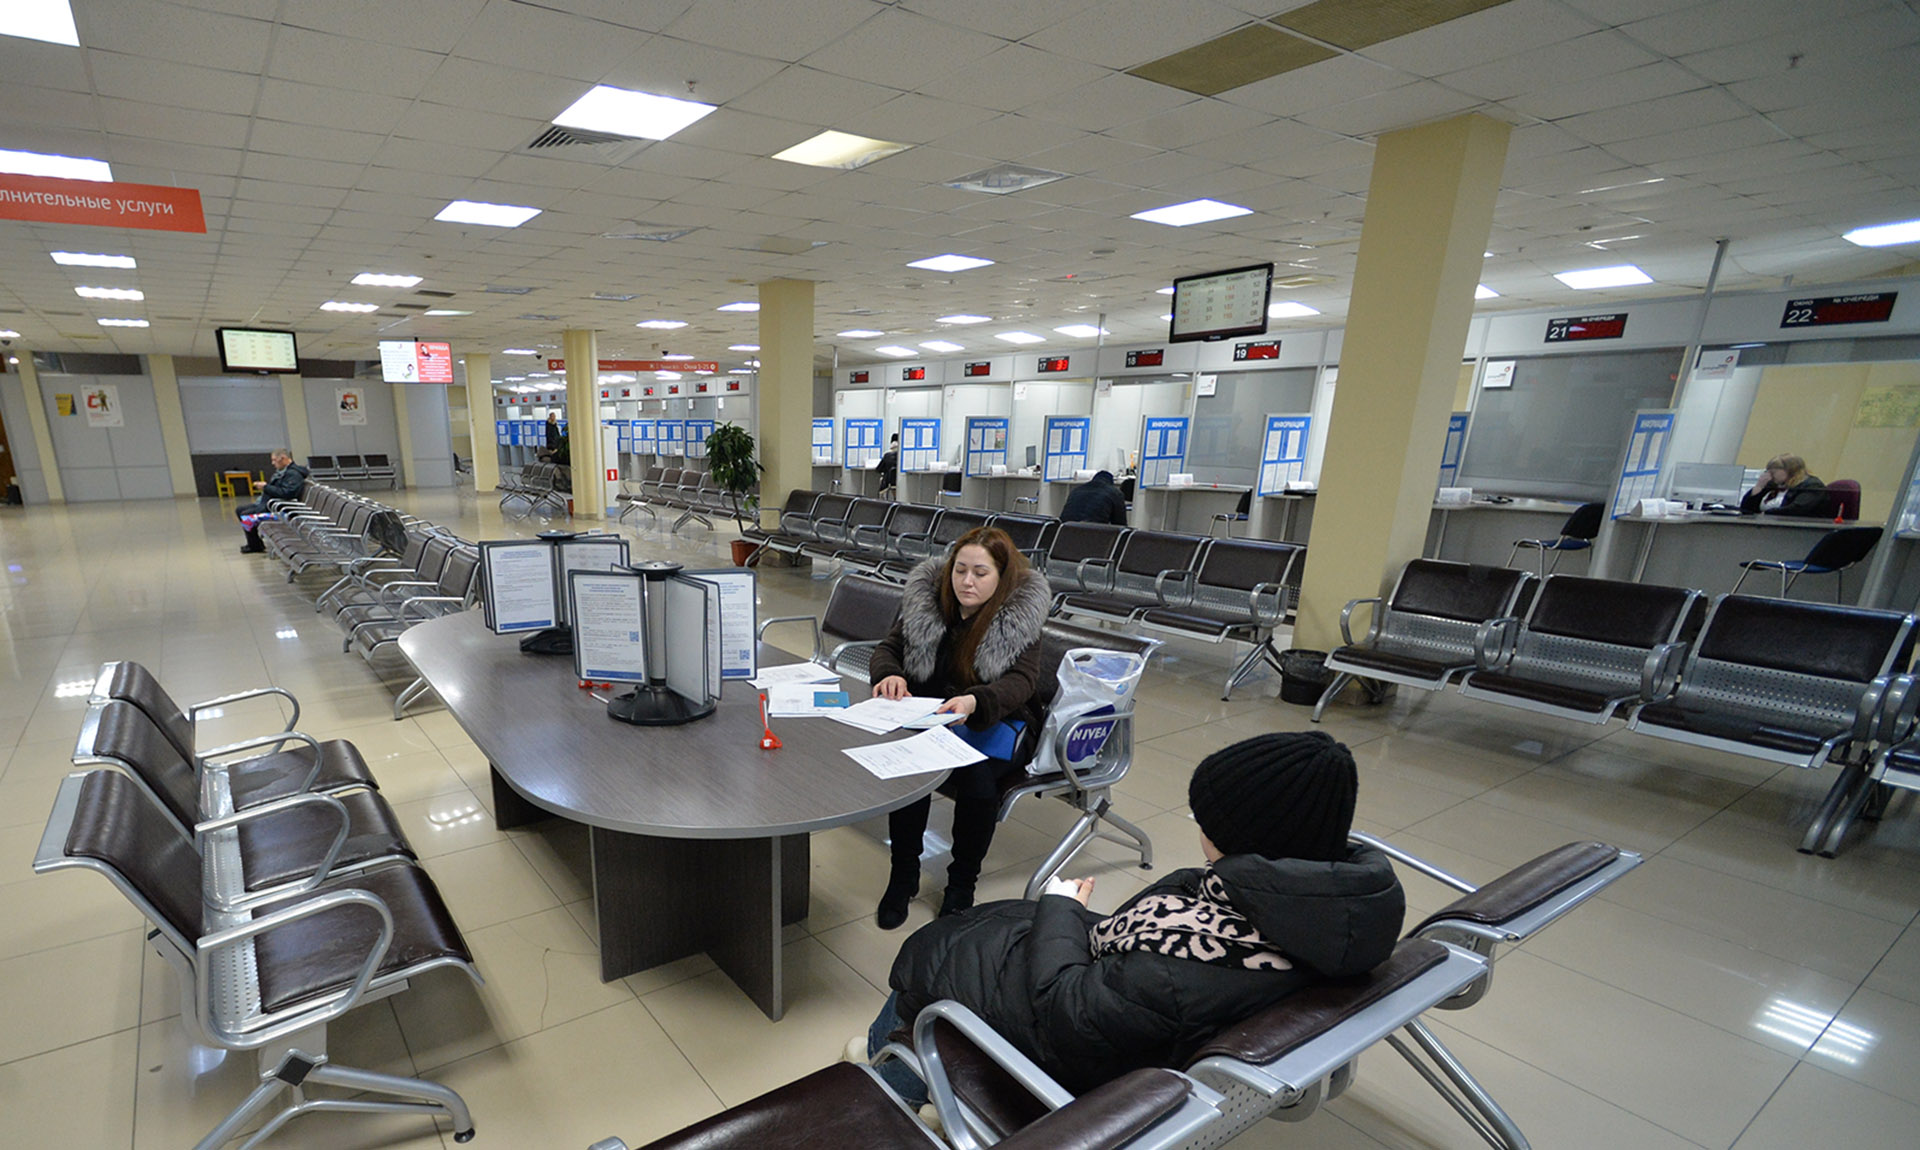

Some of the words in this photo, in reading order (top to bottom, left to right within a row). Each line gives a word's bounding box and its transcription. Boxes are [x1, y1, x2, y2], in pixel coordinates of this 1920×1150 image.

[116, 199, 174, 216] услуги
[1786, 309, 1812, 323] 22
[1549, 326, 1567, 339] 21
[1236, 348, 1247, 359] 19
[1072, 726, 1107, 741] NIVEA
